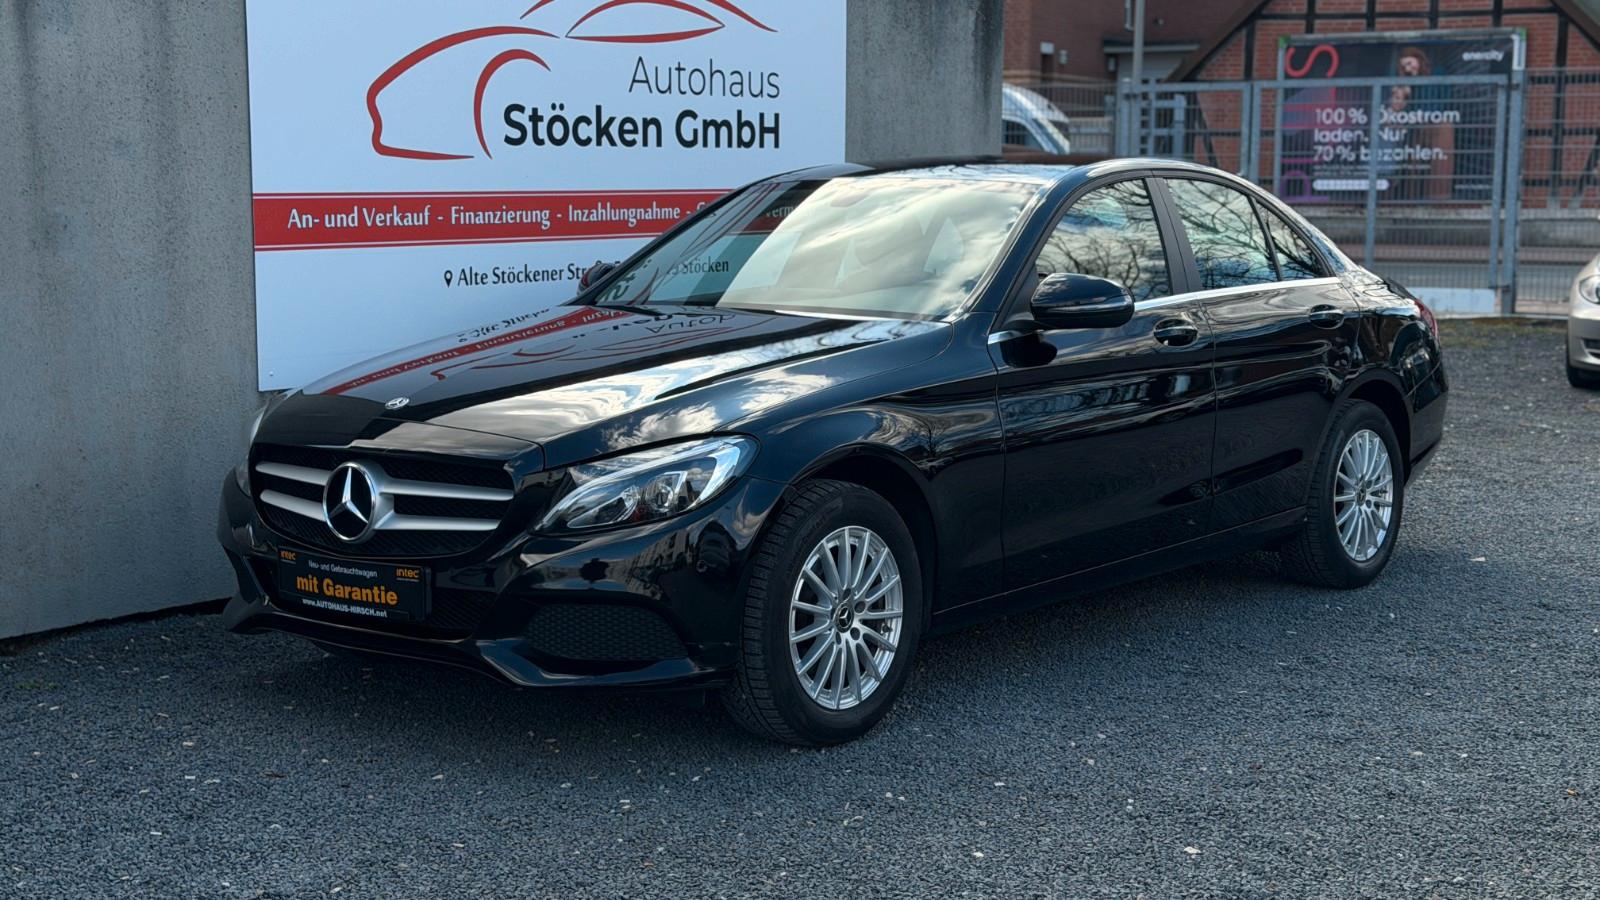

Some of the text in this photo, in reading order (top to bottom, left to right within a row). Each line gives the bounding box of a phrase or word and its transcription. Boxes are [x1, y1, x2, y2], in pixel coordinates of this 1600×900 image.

[628, 56, 780, 98] Autohaus
[503, 103, 780, 149] Stöcken GmbH
[1315, 108, 1346, 124] 100
[1348, 107, 1368, 124] %
[1313, 127, 1370, 143] laden.
[1313, 145, 1335, 162] 70
[1337, 146, 1355, 162] %
[287, 208, 320, 229] An-
[324, 205, 359, 228] und
[362, 204, 432, 227] Verkauf
[450, 203, 551, 230] Finanzierung
[568, 201, 681, 228] Inzahlungnahme
[457, 266, 489, 287] Alte
[492, 264, 565, 284] Stöckener
[296, 574, 399, 606] mit Garantie
